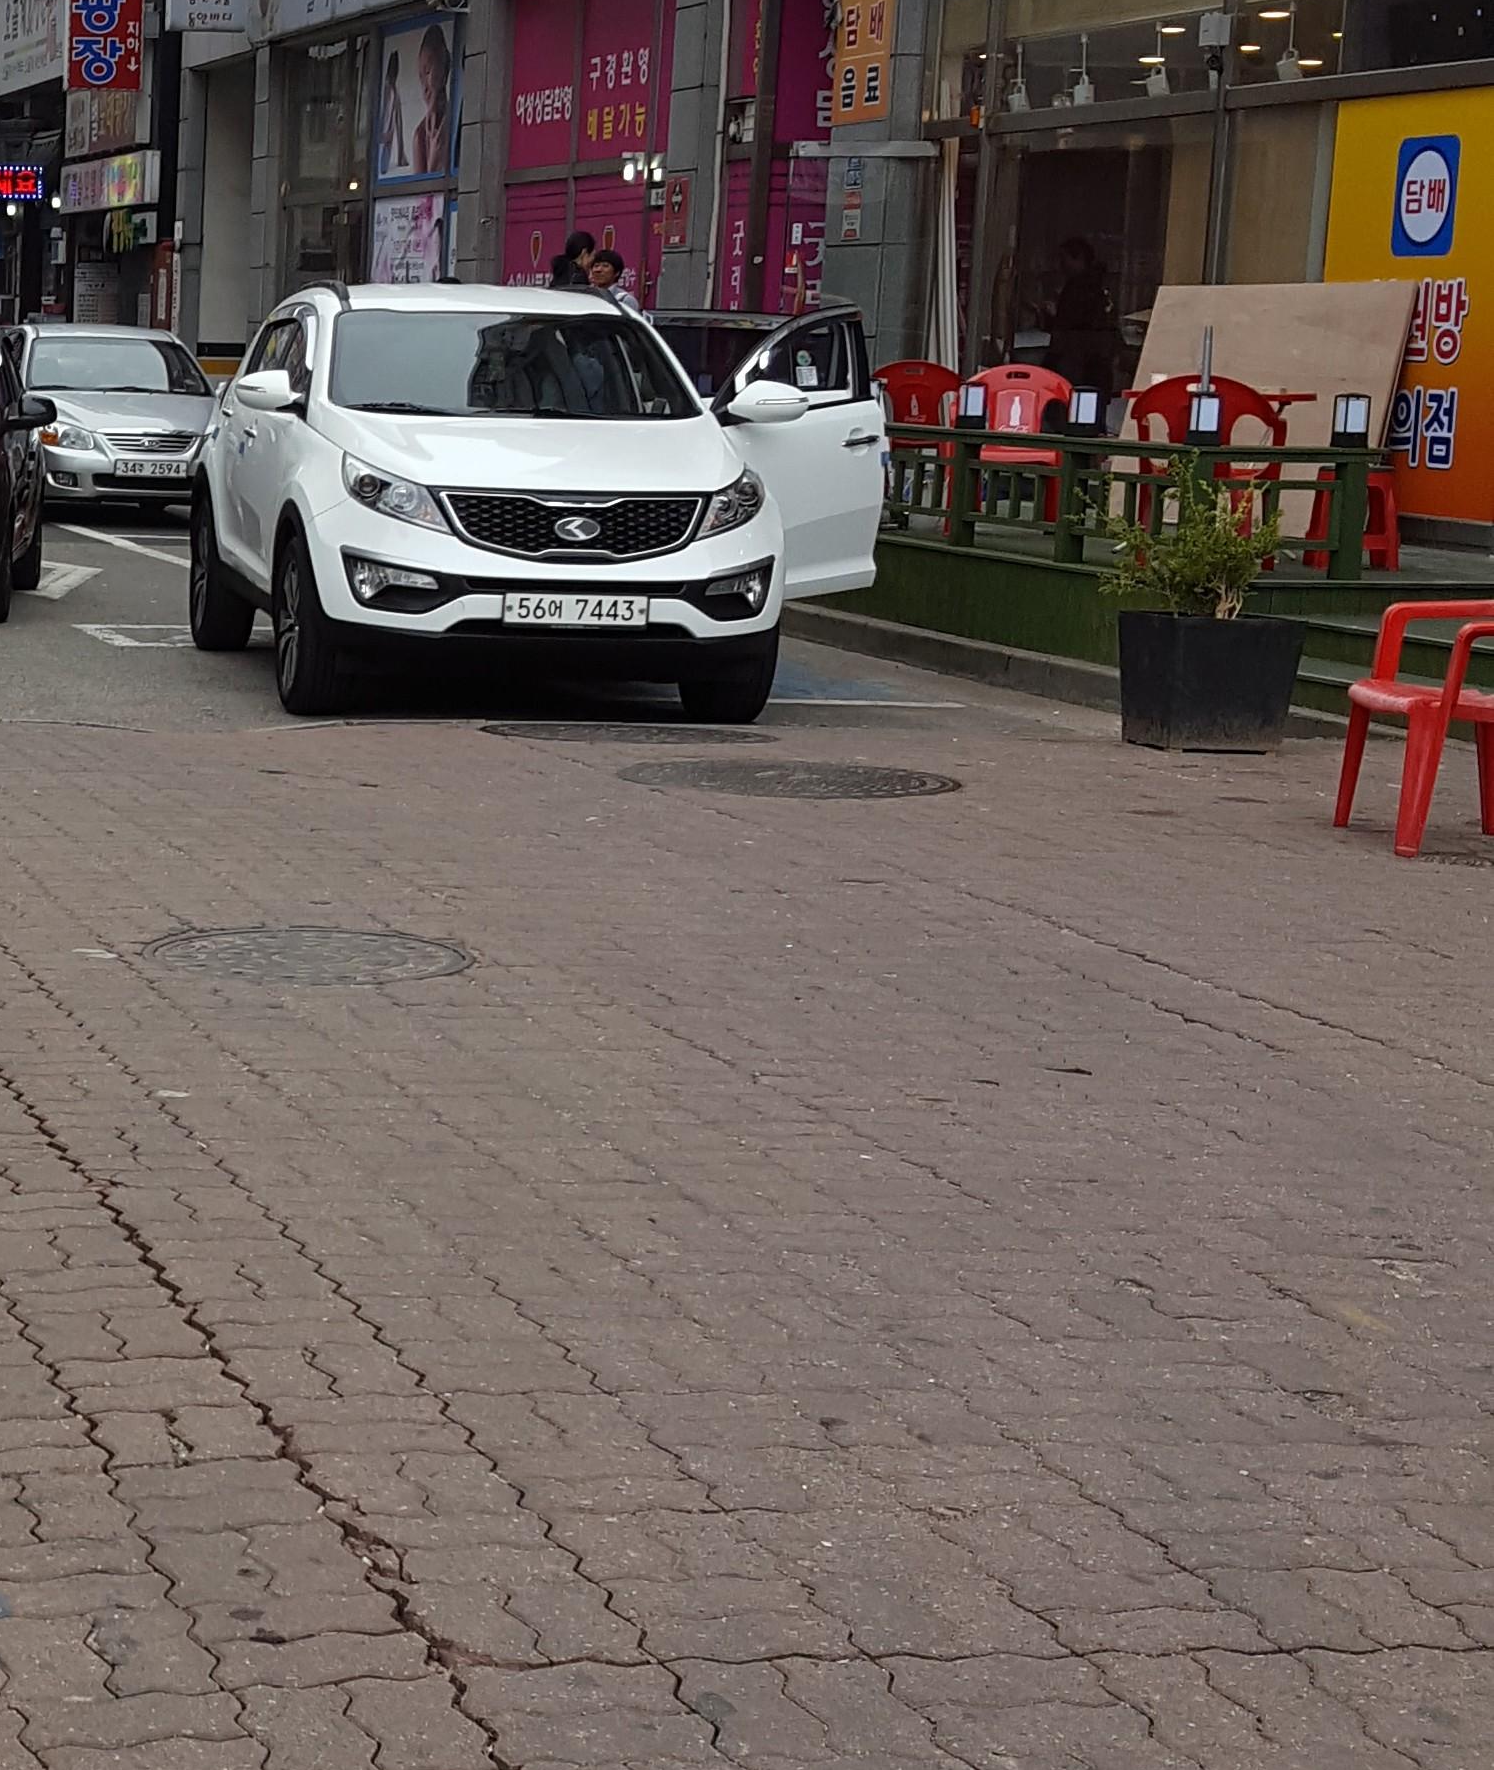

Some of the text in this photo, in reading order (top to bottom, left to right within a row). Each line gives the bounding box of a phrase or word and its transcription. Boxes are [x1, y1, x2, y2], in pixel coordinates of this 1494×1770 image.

[844, 1, 886, 49] 담배
[589, 46, 652, 92] 구경환영
[515, 85, 574, 126] 여성상담환영
[587, 101, 648, 142] 배달가능
[1405, 177, 1447, 214] 담배
[150, 462, 181, 476] 2594
[516, 596, 636, 623] 56어 7443
